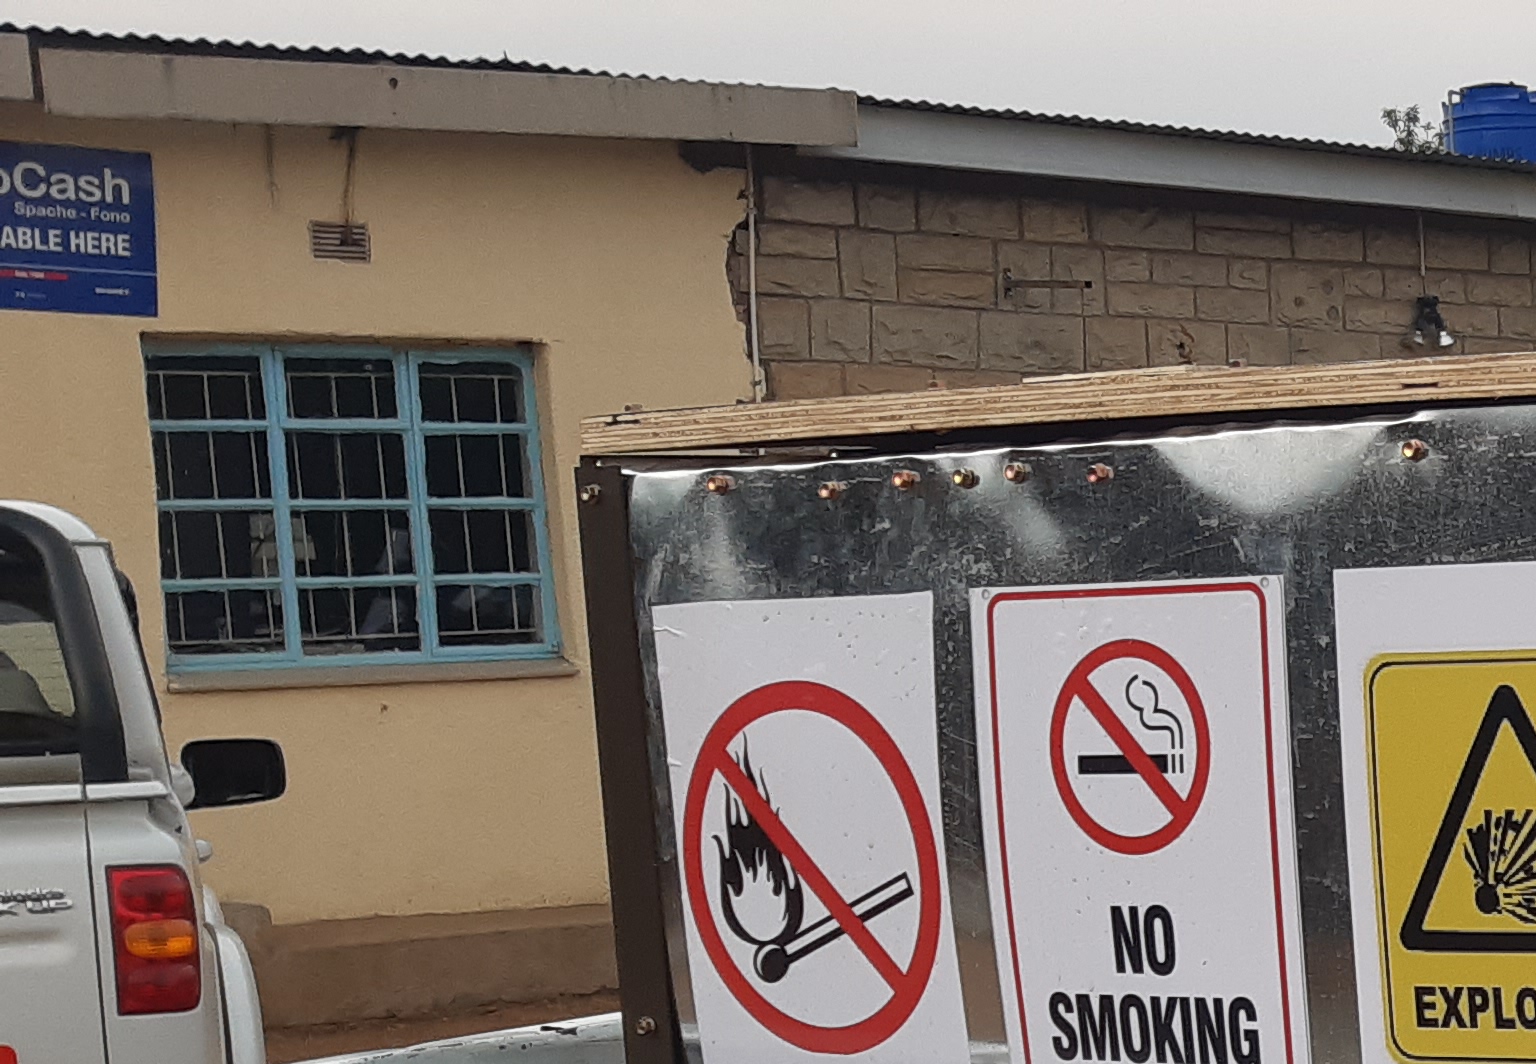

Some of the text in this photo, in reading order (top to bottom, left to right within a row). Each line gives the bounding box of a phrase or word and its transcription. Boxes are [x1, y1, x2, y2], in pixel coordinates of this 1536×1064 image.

[0, 225, 132, 257] ABLE HERE
[1110, 904, 1176, 977] NO
